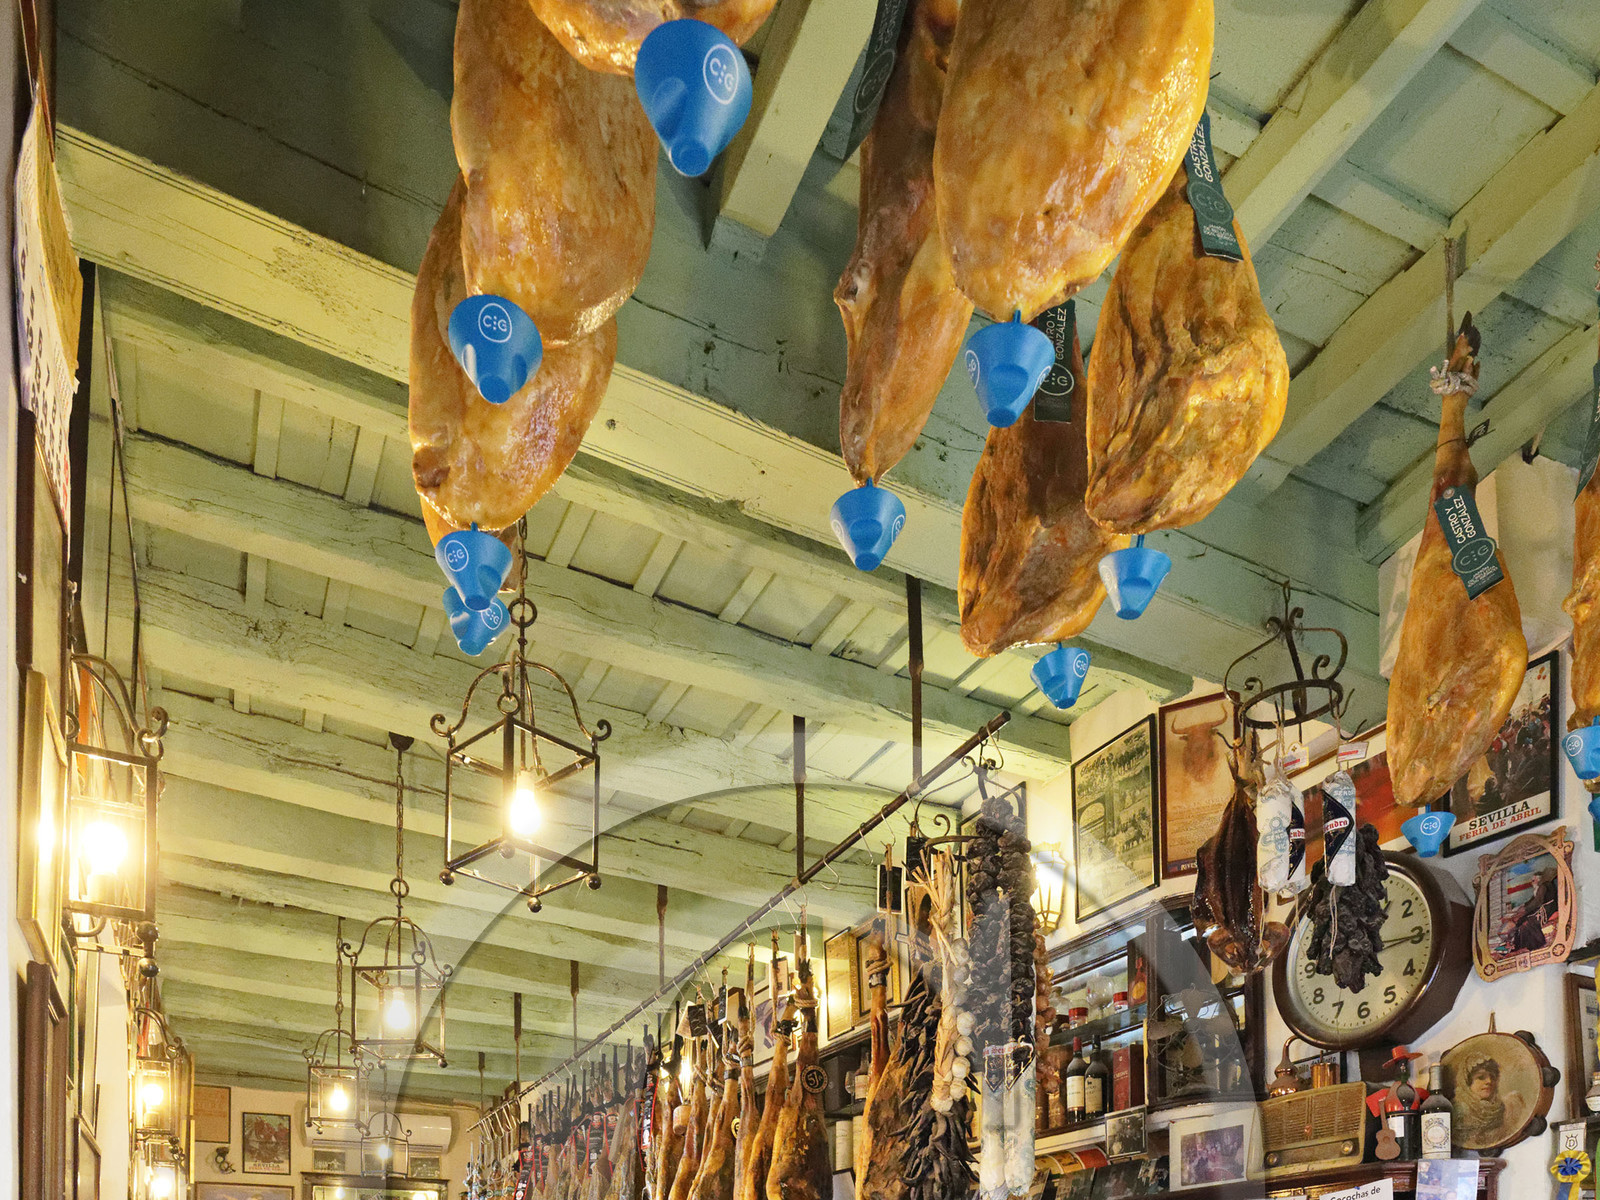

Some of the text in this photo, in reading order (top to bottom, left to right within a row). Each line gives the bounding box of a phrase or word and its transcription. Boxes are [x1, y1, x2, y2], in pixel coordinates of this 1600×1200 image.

[1448, 513, 1467, 544] CASTRO
[1459, 807, 1542, 842] FERIA DE ABRIL
[1469, 800, 1530, 831] SEVILLA
[1402, 899, 1414, 919] 2
[1410, 926, 1425, 945] 3
[1304, 962, 1317, 980] 9
[1402, 958, 1416, 977] 4
[1312, 987, 1325, 1005] 8
[1383, 985, 1397, 1004] 5
[1332, 1001, 1345, 1019] 7
[1357, 1001, 1371, 1019] 6
[1370, 1186, 1381, 1195] de
